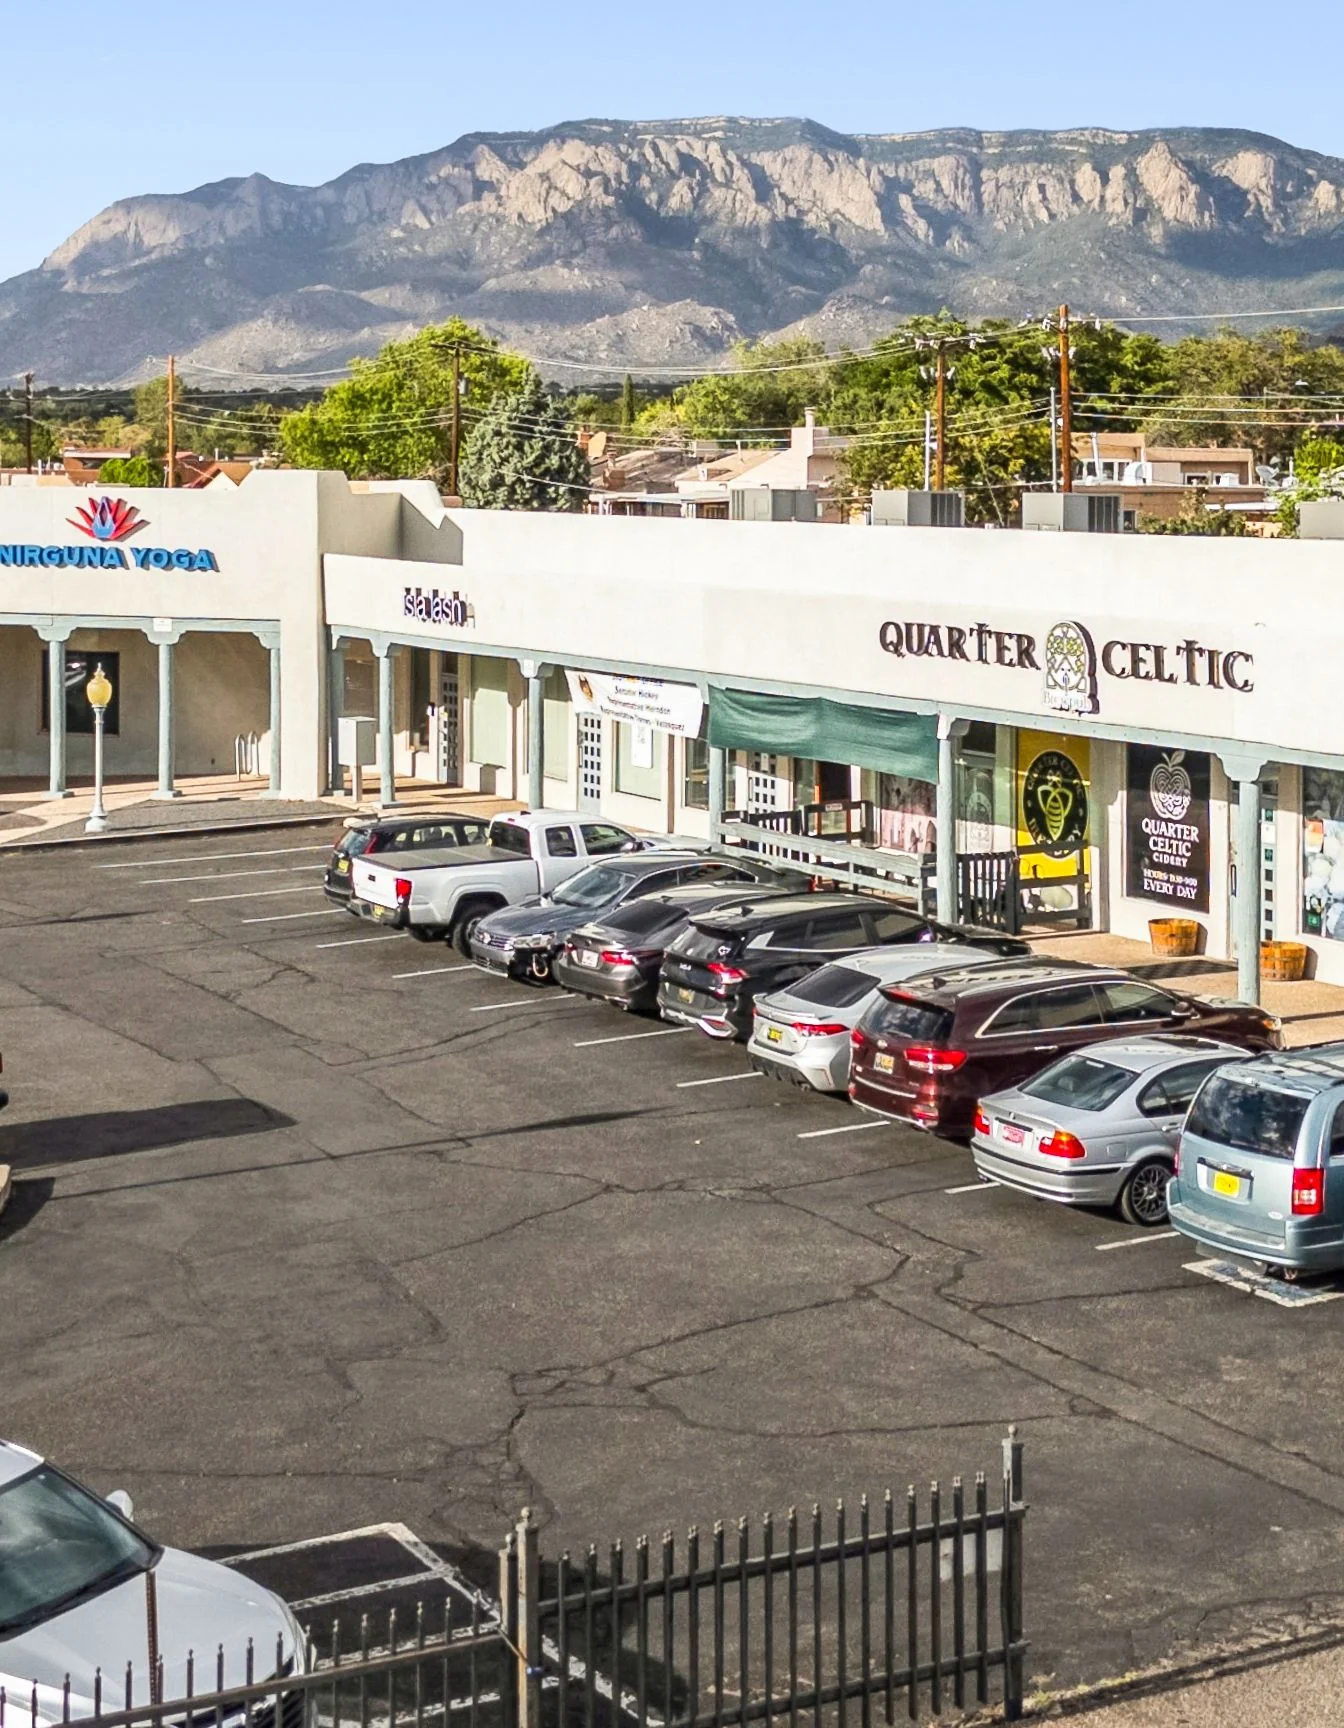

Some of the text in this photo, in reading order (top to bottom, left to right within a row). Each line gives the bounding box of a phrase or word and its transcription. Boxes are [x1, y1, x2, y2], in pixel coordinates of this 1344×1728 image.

[130, 547, 217, 571] YOGA
[879, 621, 1254, 693] QUARTER CELTIC
[1142, 818, 1199, 843] QUARTER
[1149, 836, 1192, 857] CELTIC
[1152, 852, 1188, 868] CIDERY
[1143, 878, 1197, 899] EVERY DAY
